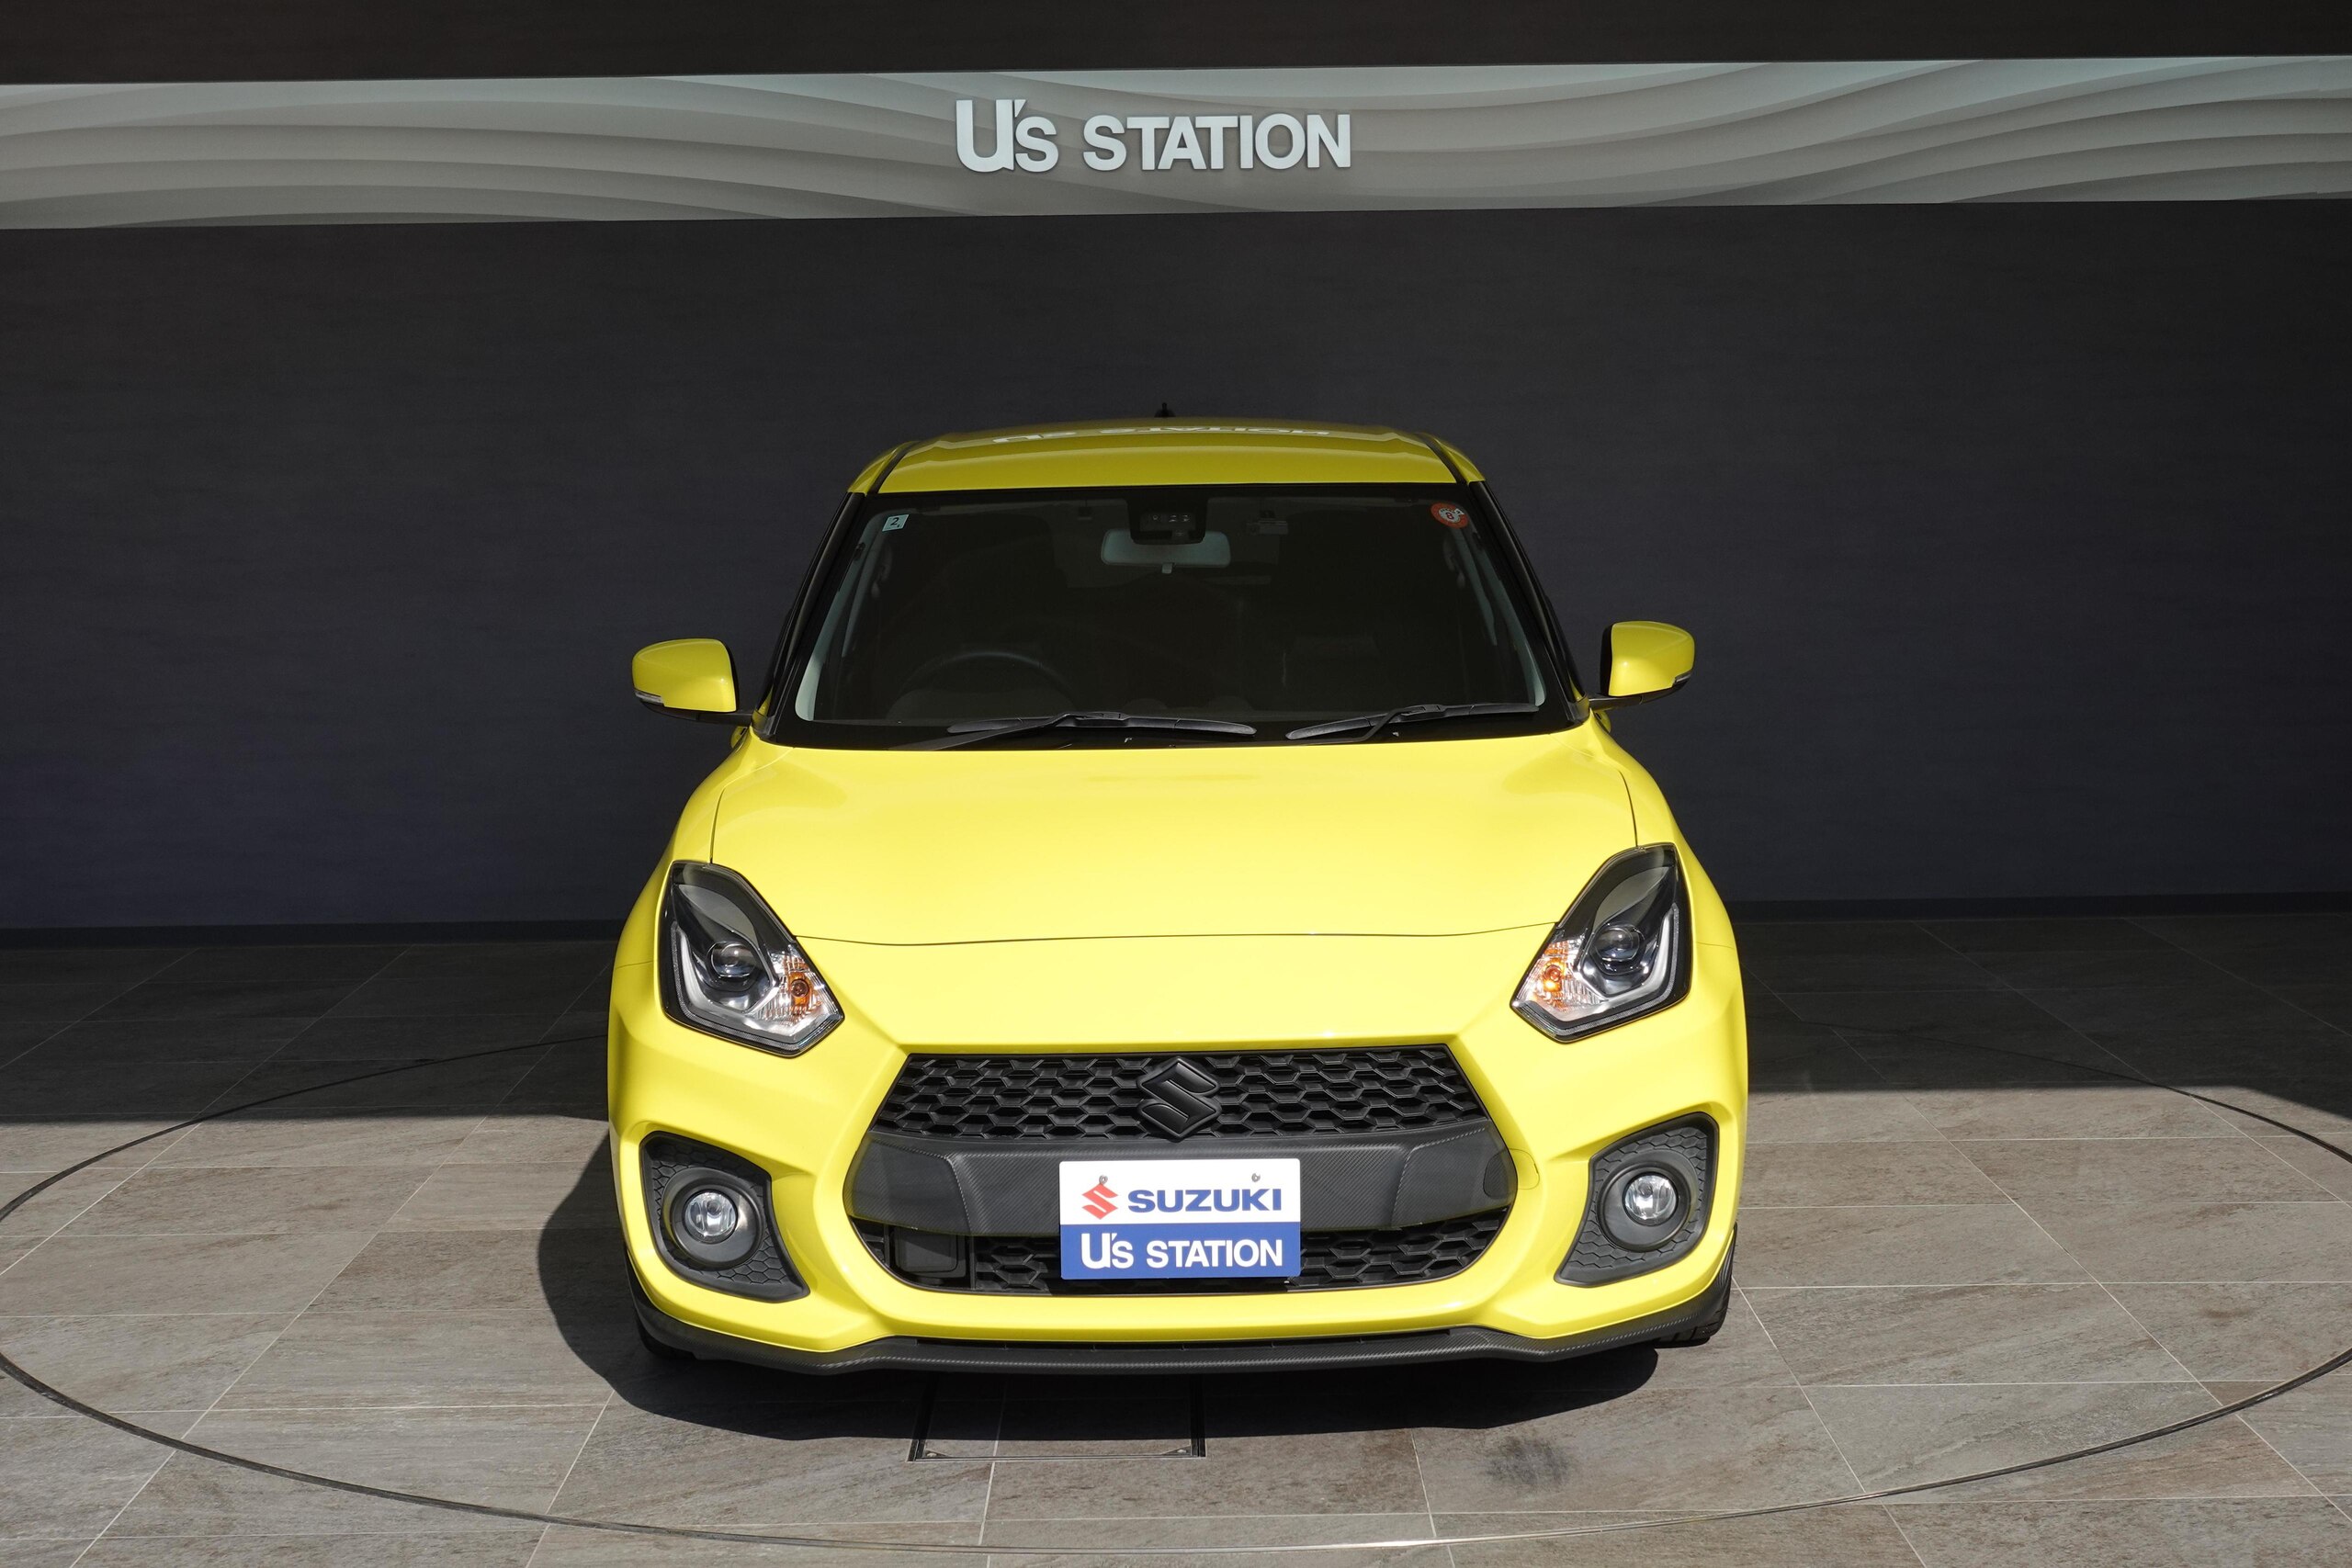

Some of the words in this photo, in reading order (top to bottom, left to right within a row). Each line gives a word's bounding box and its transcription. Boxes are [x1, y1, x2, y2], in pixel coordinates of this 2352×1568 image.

[956, 98, 1058, 173] U's
[1082, 113, 1351, 171] STATION
[890, 517, 899, 525] 2
[1127, 1189, 1282, 1213] SUZUKI
[1080, 1233, 1135, 1269] U's
[1146, 1239, 1283, 1269] STATION
